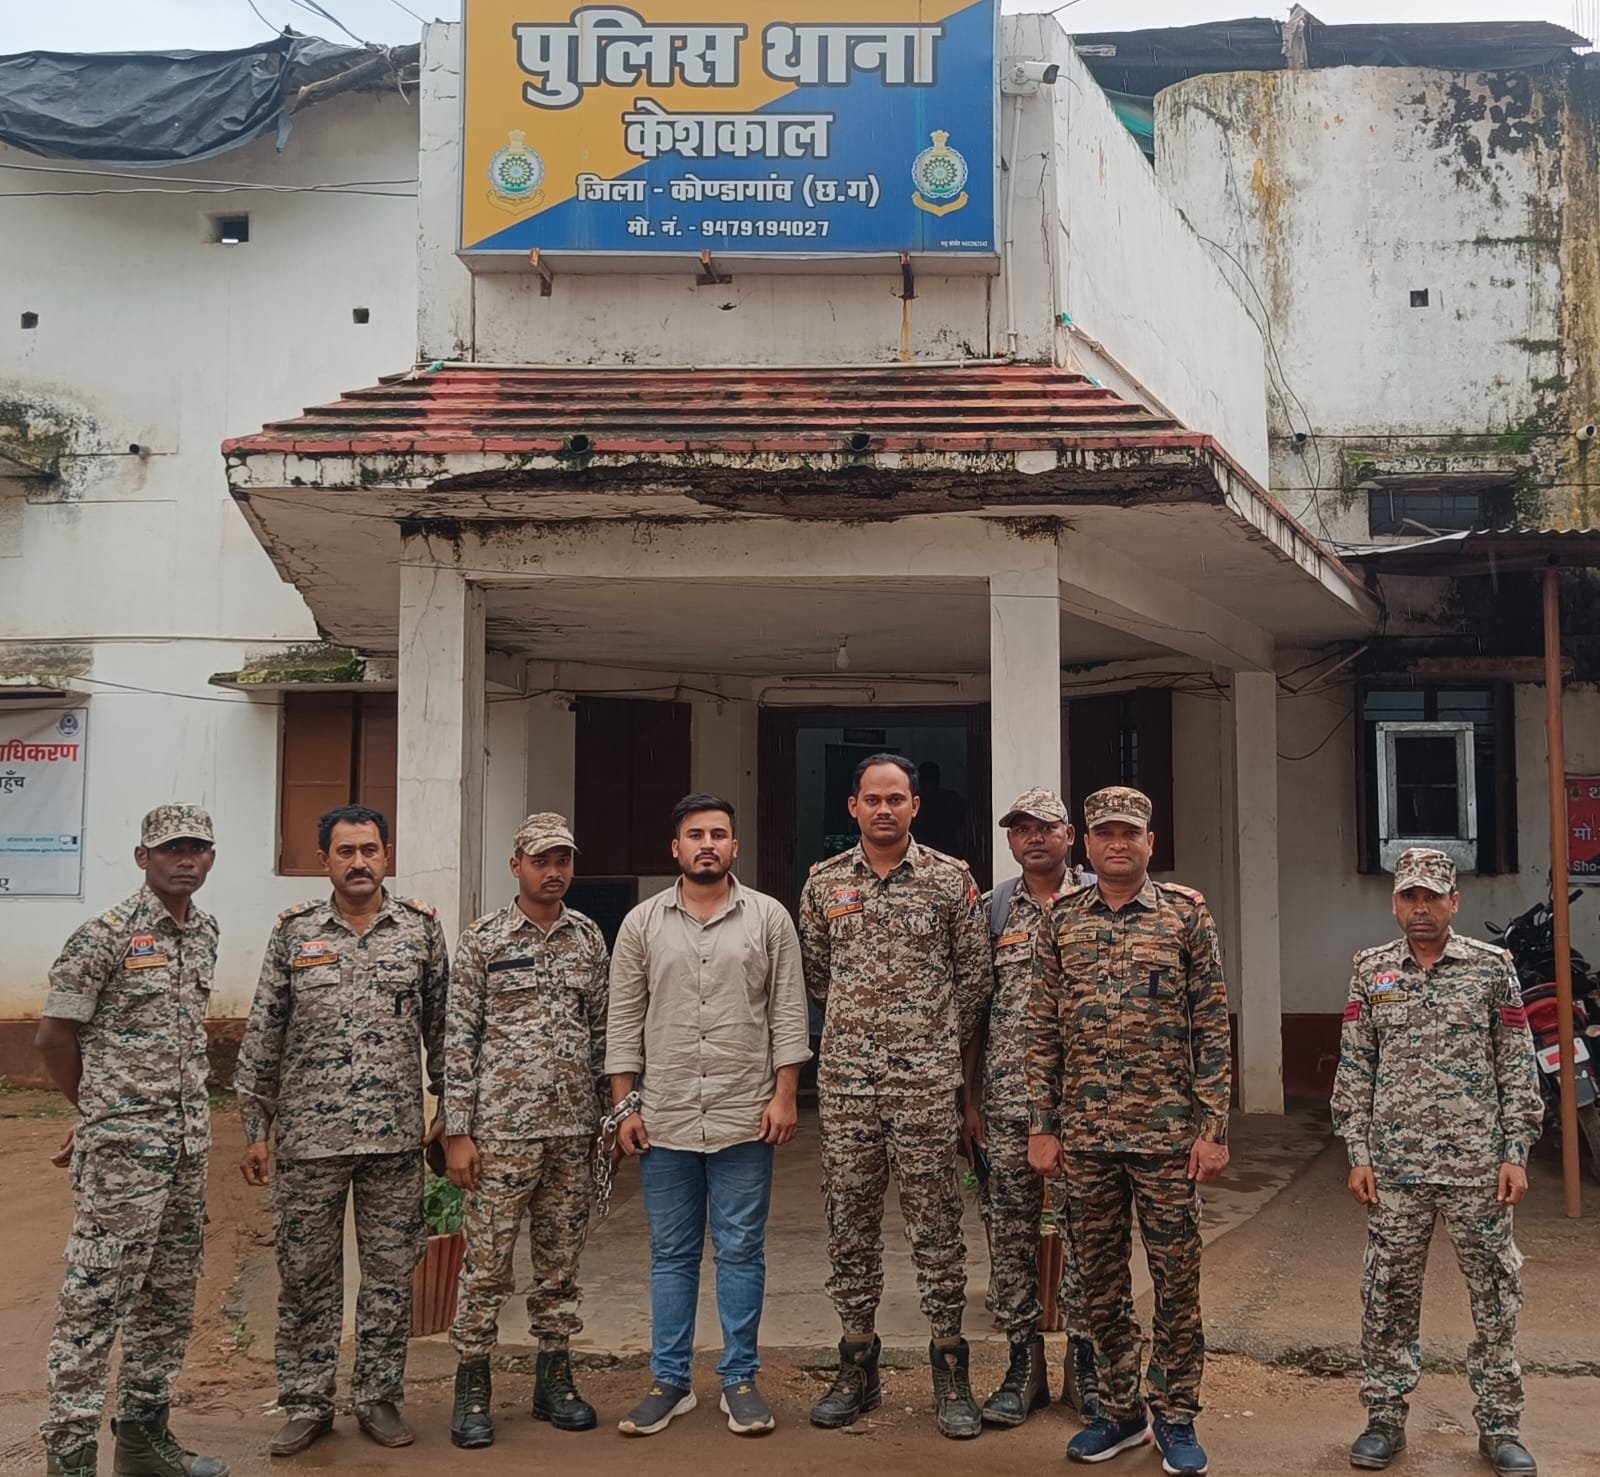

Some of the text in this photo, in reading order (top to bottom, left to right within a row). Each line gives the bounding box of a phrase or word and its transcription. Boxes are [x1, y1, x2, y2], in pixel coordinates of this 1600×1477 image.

[513, 6, 945, 108] पुलिस थाना
[621, 98, 835, 158] केशकाल
[576, 173, 647, 202] जिला
[669, 173, 794, 202] कोण्डागांव
[802, 174, 881, 208] (छ.ग)
[627, 217, 656, 236] मो.
[701, 220, 830, 236] 9479194027
[0, 769, 26, 794] हुँच
